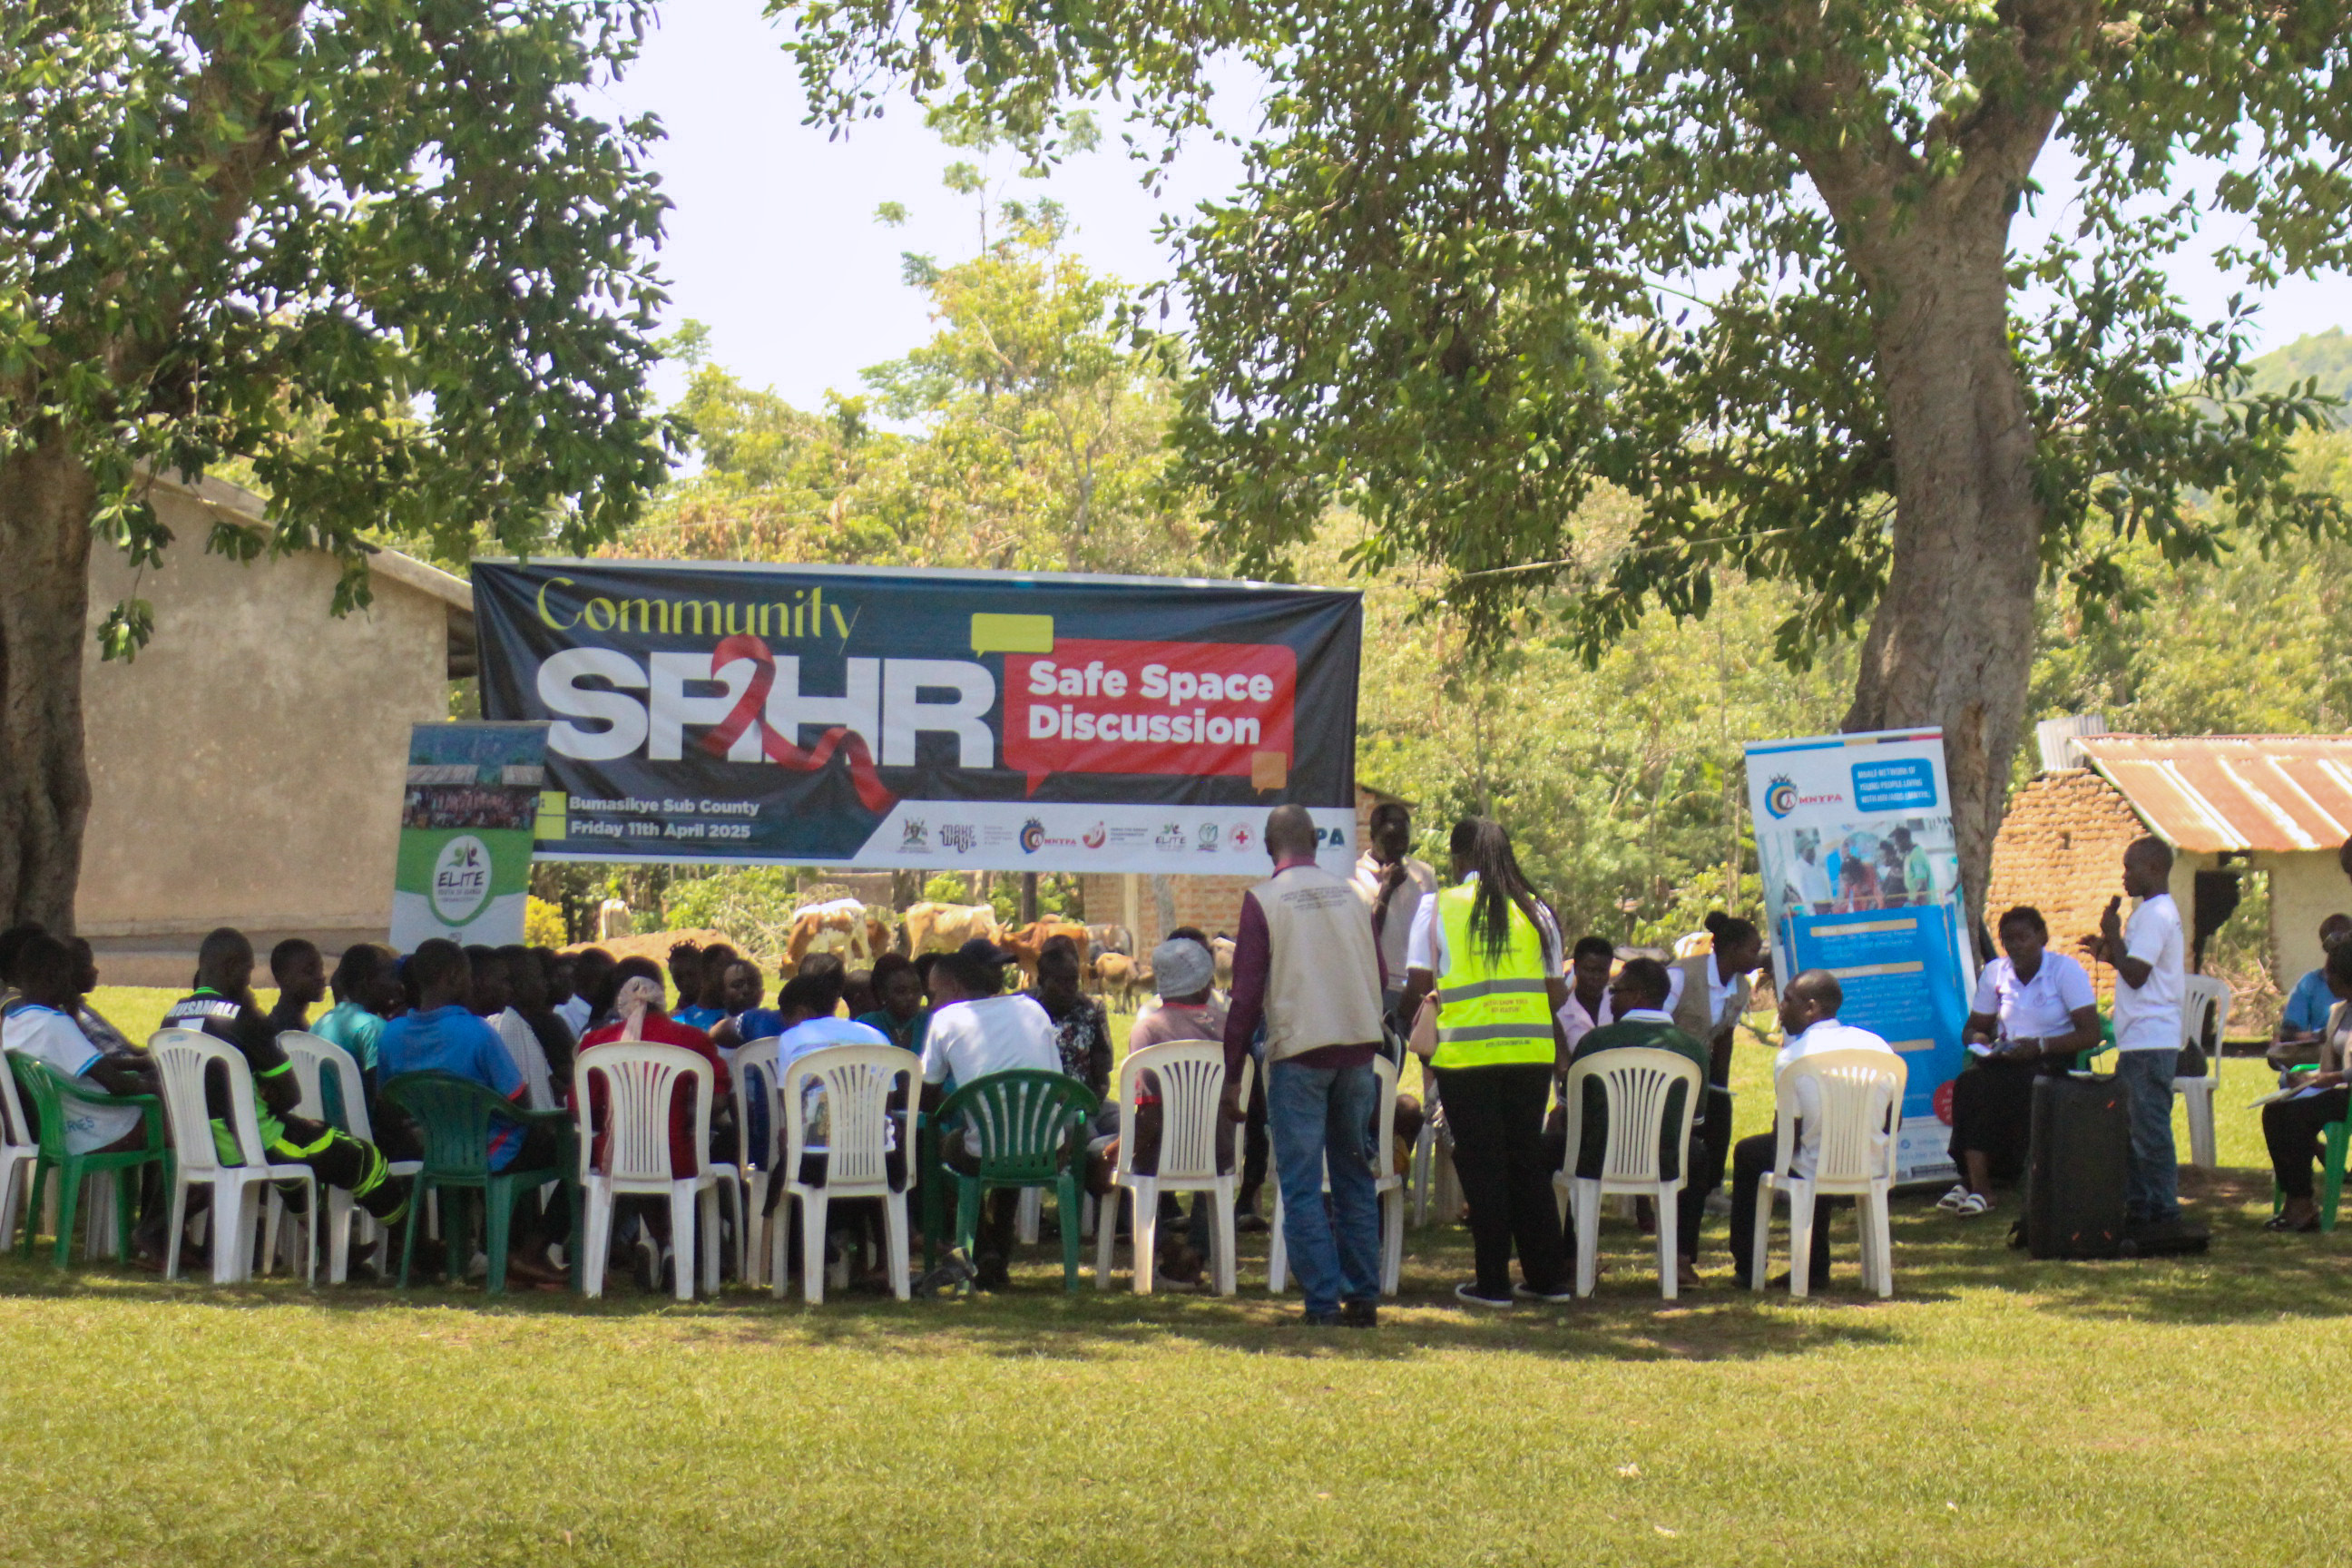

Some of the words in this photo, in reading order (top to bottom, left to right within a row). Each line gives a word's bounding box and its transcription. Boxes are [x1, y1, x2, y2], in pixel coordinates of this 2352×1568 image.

[537, 576, 861, 655] Community
[1028, 660, 1128, 698] Safe
[1140, 662, 1274, 706] Space
[1029, 704, 1260, 745] Discussion
[569, 796, 660, 814] Bumasikye
[663, 799, 695, 813] Sub
[700, 799, 760, 817] County
[1798, 793, 1843, 805] MNYPA
[571, 820, 623, 838] Friday
[628, 821, 660, 836] 11th
[664, 823, 704, 838] April
[708, 824, 751, 838] 2025
[1155, 836, 1187, 845] ELITE
[437, 871, 485, 887] ELITE
